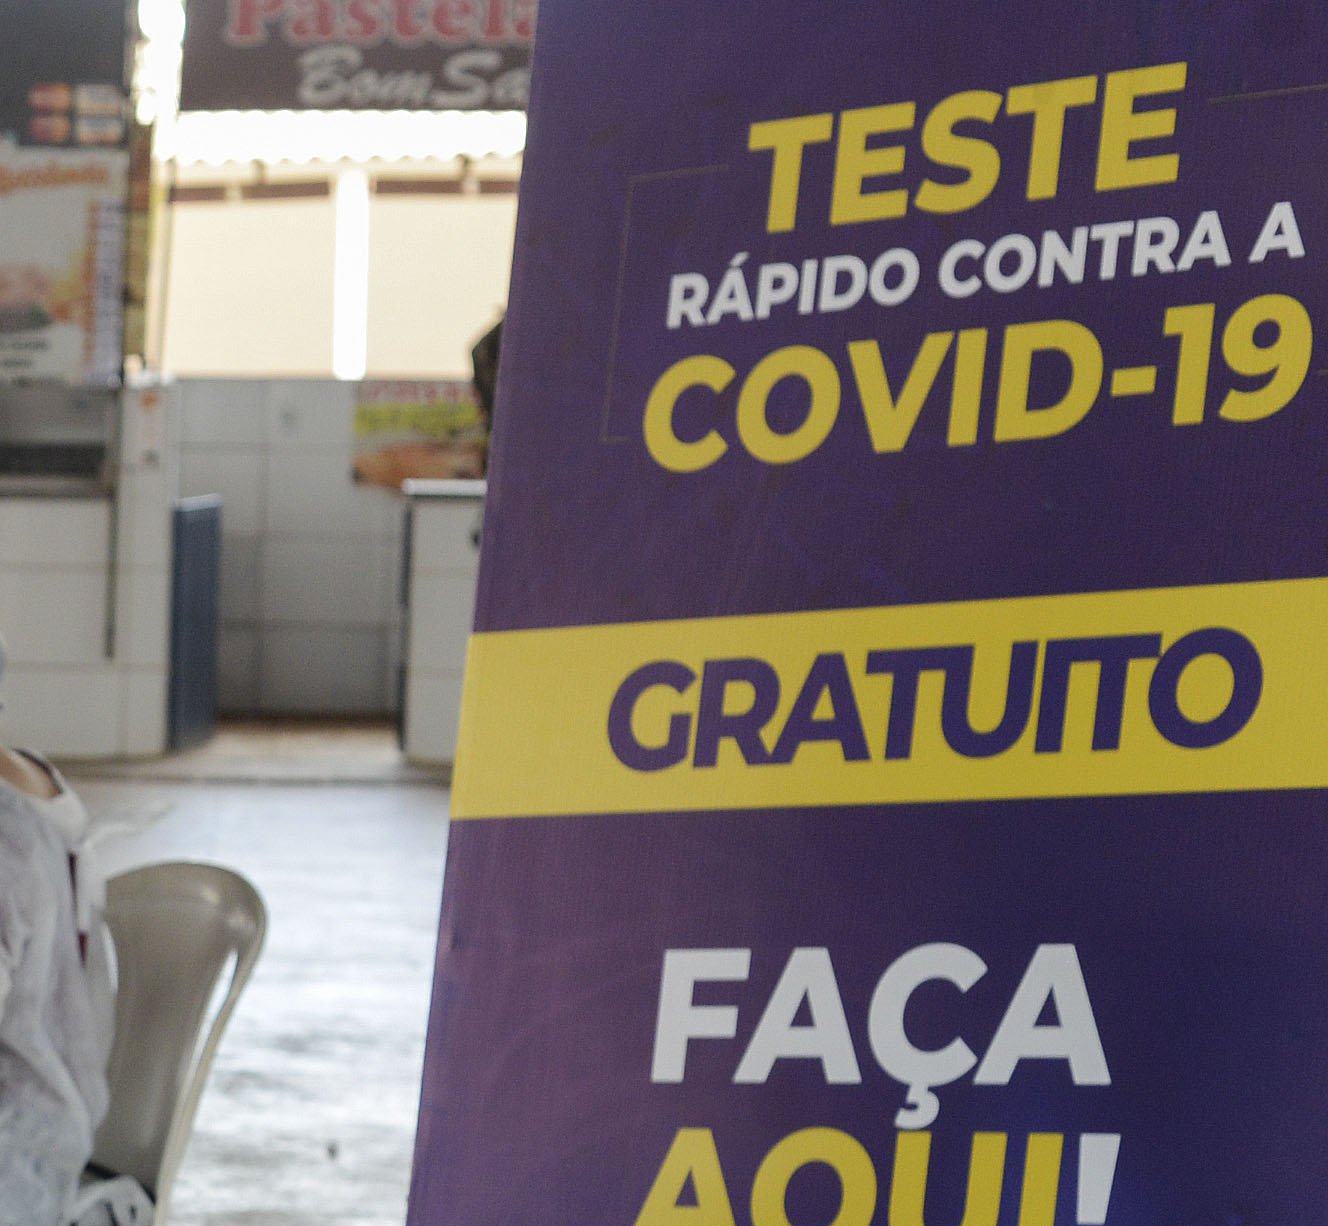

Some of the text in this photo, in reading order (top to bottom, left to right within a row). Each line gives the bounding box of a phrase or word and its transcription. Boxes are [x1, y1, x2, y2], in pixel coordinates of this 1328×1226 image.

[747, 61, 1188, 233] TESTE
[666, 201, 1306, 329] RÁPIDO CONTRA A
[643, 293, 1314, 474] COVID-19
[606, 625, 1264, 773] GRATUITO
[650, 942, 1112, 1130] FAÇA
